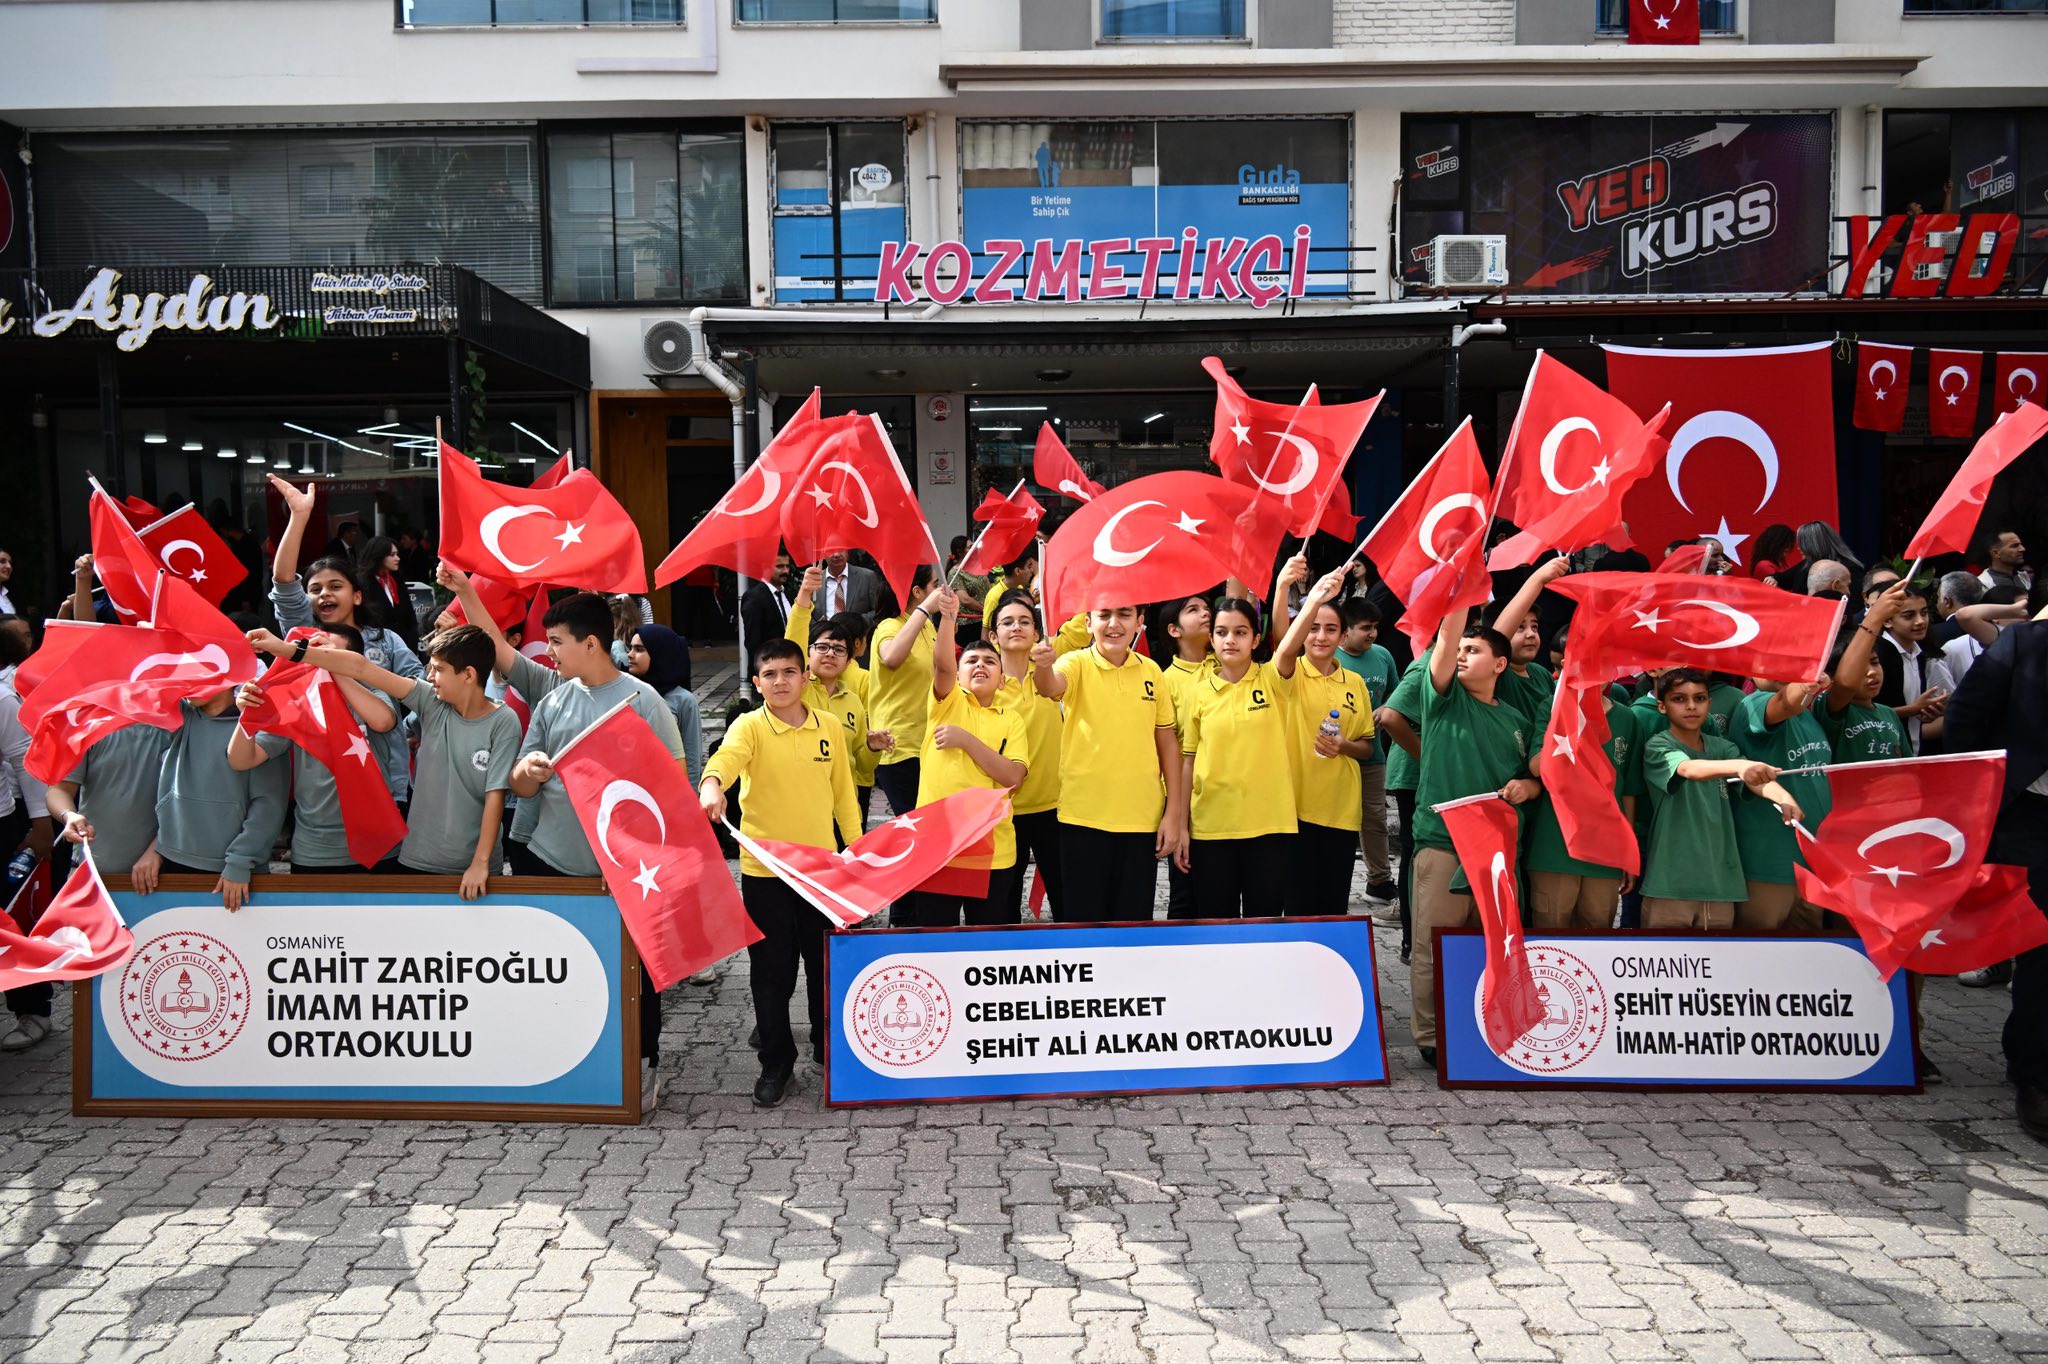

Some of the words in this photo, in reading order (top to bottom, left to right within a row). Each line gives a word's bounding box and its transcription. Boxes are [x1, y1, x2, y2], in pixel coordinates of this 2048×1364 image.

[1238, 163, 1300, 185] Gıda
[1429, 158, 1457, 176] KURS
[1031, 195, 1043, 205] Bir
[1044, 195, 1072, 205] Yetime
[1242, 184, 1299, 195] BANKACILIĞI
[1562, 160, 1666, 227] YED
[1982, 174, 2013, 198] KURS
[1033, 207, 1055, 218] Sahip
[1057, 207, 1070, 219] Çık
[1628, 188, 1772, 271] KURS
[873, 223, 1311, 309] KOZMETİKÇİ
[1845, 213, 2021, 298] YED
[313, 275, 337, 288] Hair
[340, 274, 370, 288] Make
[371, 273, 387, 291] Up
[33, 267, 281, 352] Aydın
[1144, 680, 1154, 696] C
[1252, 689, 1265, 704] C
[820, 739, 829, 757] C
[266, 934, 345, 950] OSMANİYE
[207, 965, 226, 994] EĞİTİM
[267, 951, 369, 984] CAHİT
[377, 950, 568, 984] ZARİFOĞLU
[964, 959, 1094, 986] OSMANİYE
[1611, 953, 1712, 979] OSMANİYE
[144, 955, 179, 1006] CUMHURİYETİ
[1564, 978, 1583, 1006] EĞİTİM
[195, 996, 226, 1035] BAKANLIĞI
[267, 988, 362, 1021] İMAM
[372, 988, 469, 1021] HATİP
[965, 995, 1166, 1023] CEBELİBEREKET
[1614, 987, 1673, 1021] ŞEHİT
[1678, 987, 1771, 1017] HÜSEYİN
[1776, 988, 1854, 1017] CENGİZ
[1555, 1009, 1584, 1047] BAKANLIĞI
[1616, 1025, 1745, 1055] İMAM-HATİP
[1751, 1032, 1880, 1057] ORTAOKULU
[267, 1030, 472, 1058] ORTAOKULU
[966, 1032, 1040, 1065] ŞEHİT
[1047, 1030, 1087, 1056] ALİ
[1095, 1032, 1178, 1055] ALKAN
[1185, 1026, 1333, 1051] ORTAOKULU
